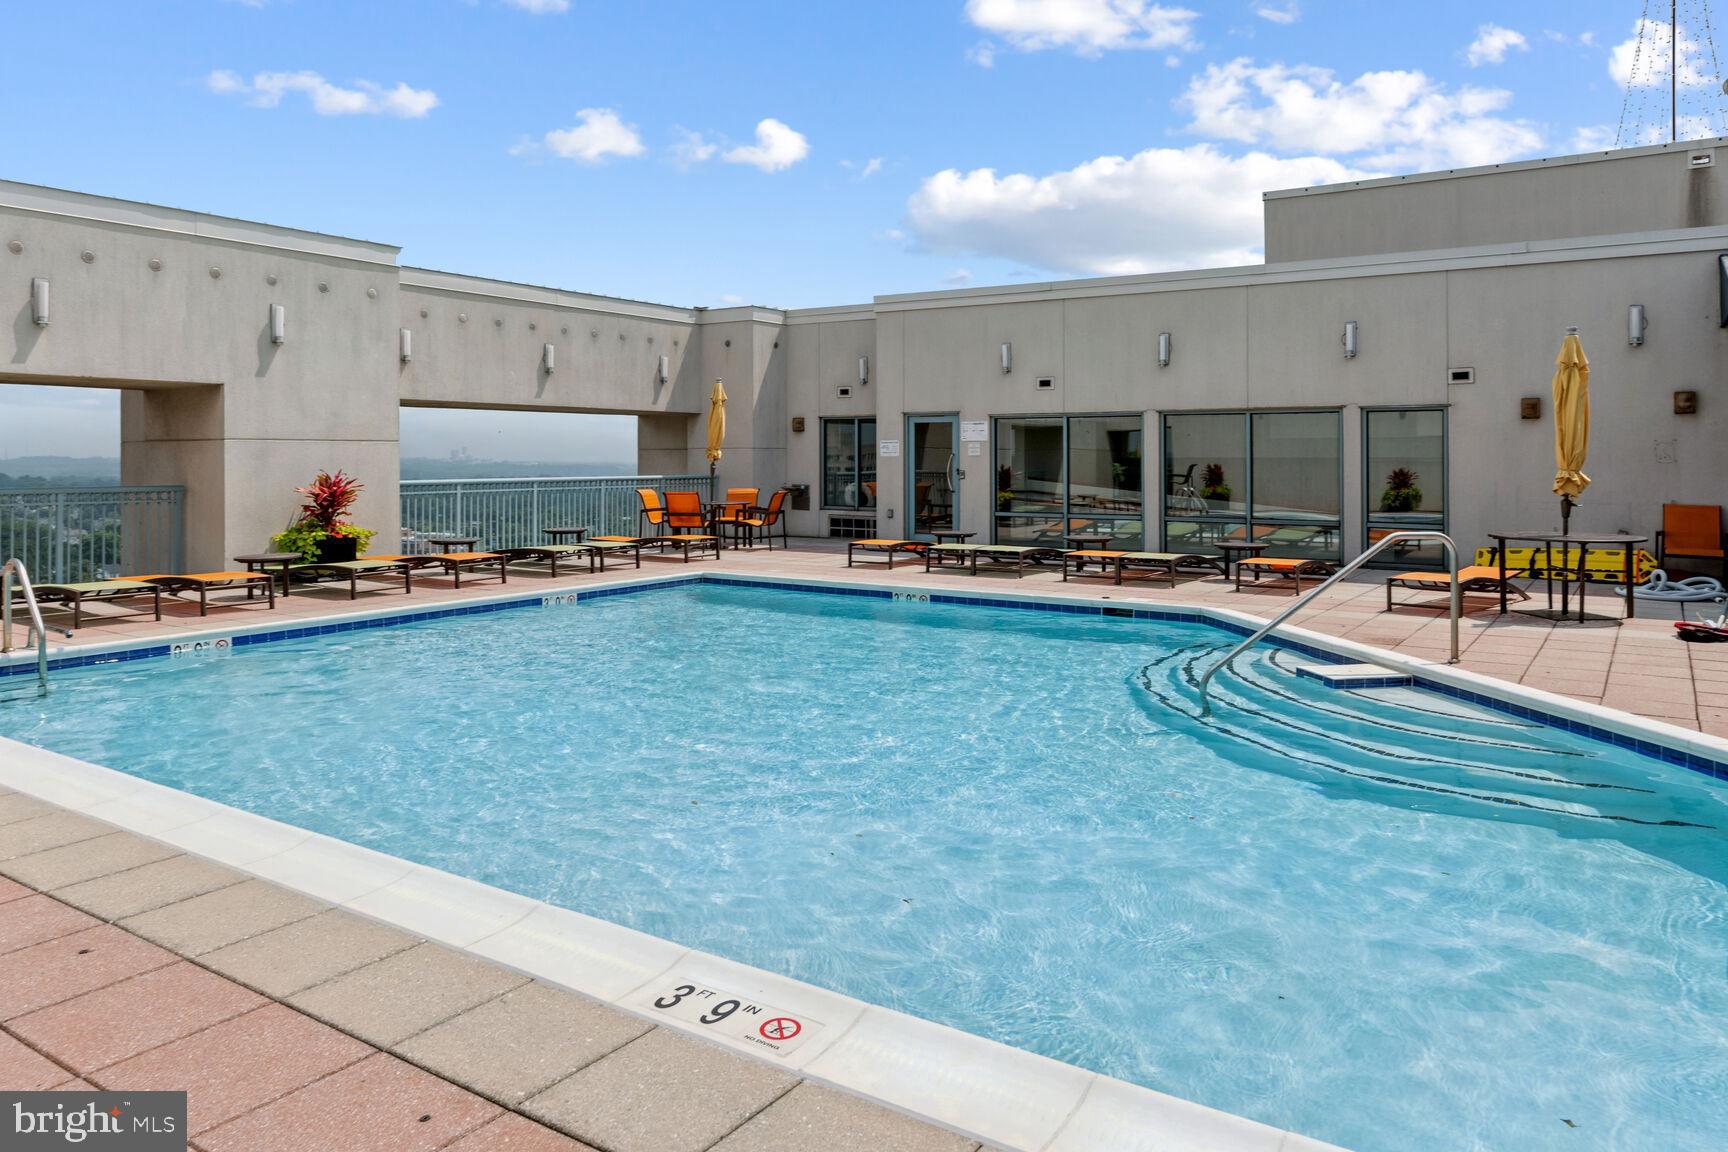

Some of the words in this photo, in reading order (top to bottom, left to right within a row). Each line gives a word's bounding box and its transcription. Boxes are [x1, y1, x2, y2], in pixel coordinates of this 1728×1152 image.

[654, 985, 696, 1009] 3
[697, 989, 716, 999] FT
[700, 999, 741, 1025] 9
[742, 1004, 763, 1015] IN
[744, 1034, 756, 1042] NO
[755, 1038, 781, 1050] DIVING
